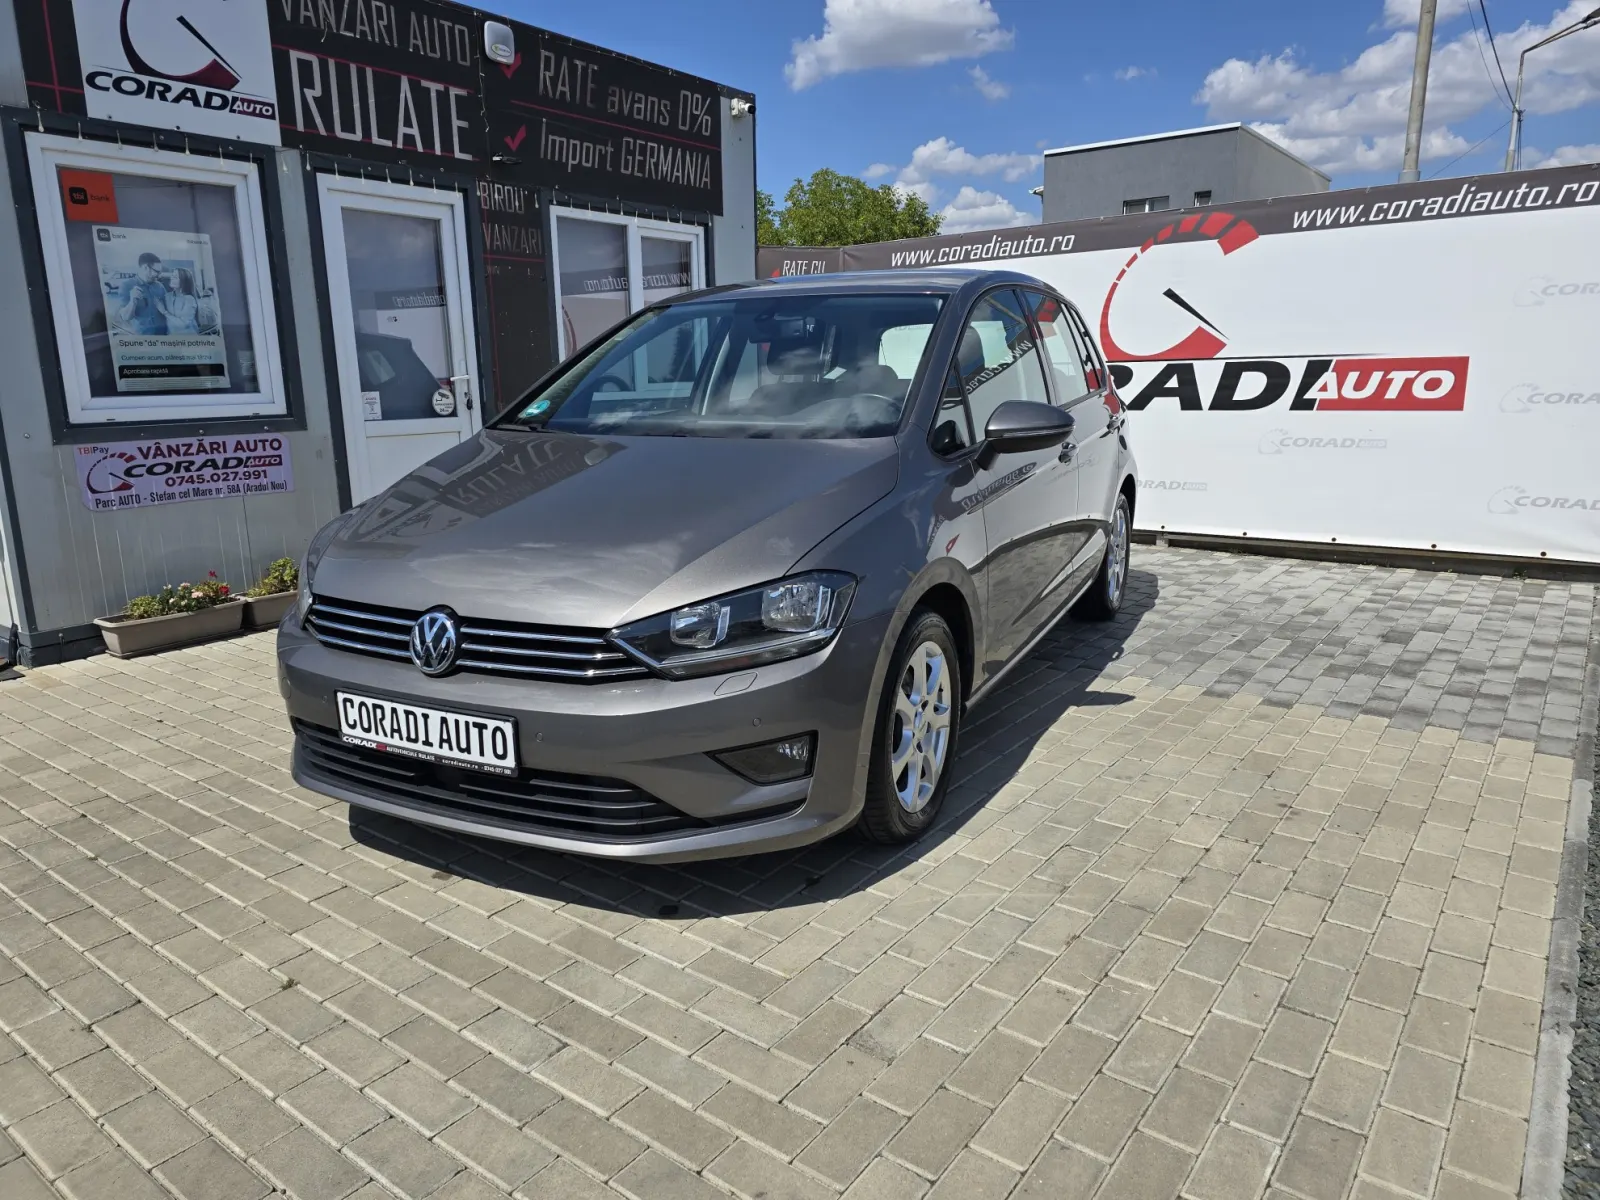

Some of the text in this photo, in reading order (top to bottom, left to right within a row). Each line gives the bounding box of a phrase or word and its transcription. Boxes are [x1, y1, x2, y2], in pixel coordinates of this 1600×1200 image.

[409, 12, 470, 66] AUTO
[85, 70, 273, 117] CORADI AUTO
[289, 49, 473, 161] RULATE
[539, 50, 711, 137] RATE avans 0%
[540, 118, 711, 190] Import GERMANIA
[90, 193, 110, 202] bank
[480, 181, 525, 214] BIROU
[1292, 180, 1600, 230] www.coradiauto.ro
[482, 223, 542, 255] VANZARI
[891, 233, 1075, 267] www.coradiauto.ro
[782, 260, 826, 277] RATE CU
[1541, 282, 1600, 296] COR
[119, 339, 143, 348] Spune
[187, 339, 216, 347] potrivite
[1304, 369, 1455, 400] AUTO
[78, 446, 109, 456] TBIPay
[136, 437, 282, 461] VÂNZĂRI AUTO
[1279, 437, 1361, 448] CORADI
[123, 456, 280, 478] CORADI AUTO
[165, 469, 268, 488] 0745.027.991
[95, 498, 116, 508] Parc
[118, 493, 141, 506] AUTO
[178, 488, 191, 499] cel
[192, 486, 213, 497] Mare
[215, 486, 226, 495] nr.
[227, 483, 241, 494] 58A
[243, 482, 269, 495] (Aradul
[270, 480, 288, 492] Nou)
[342, 697, 508, 761] CORADI AUTO
